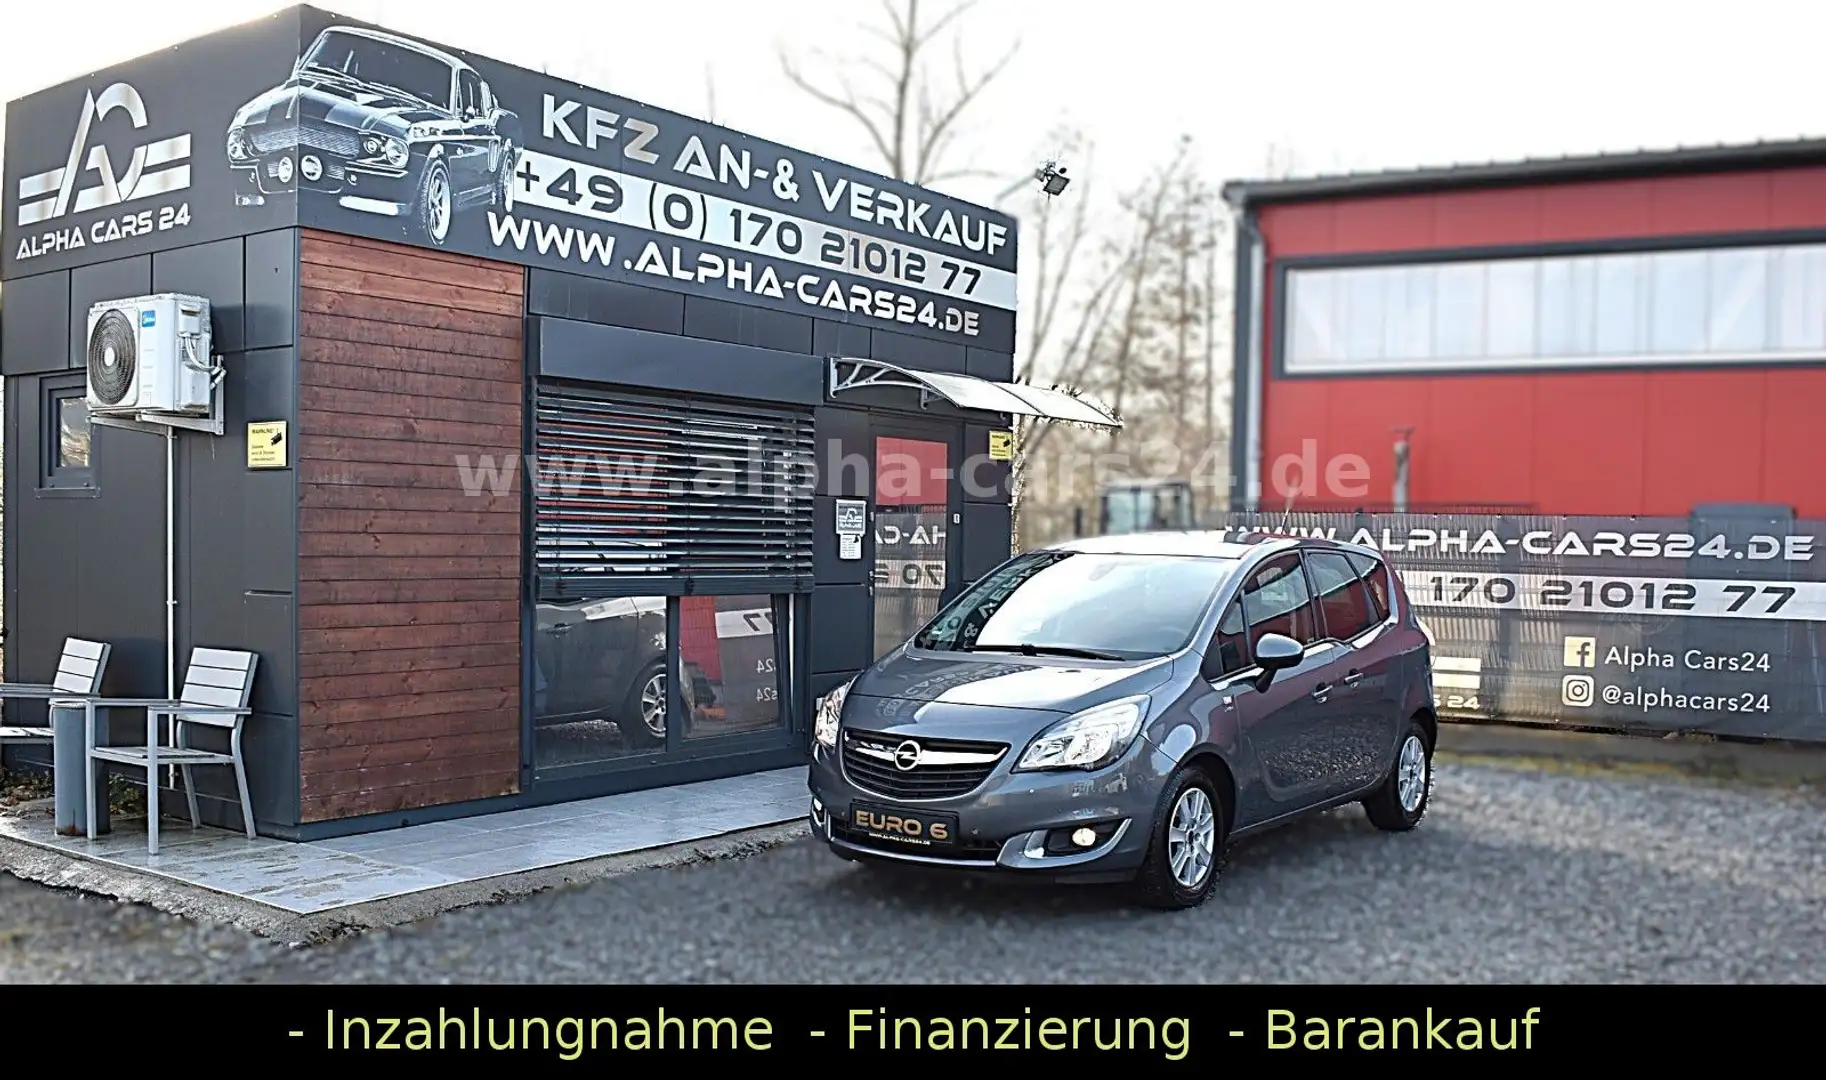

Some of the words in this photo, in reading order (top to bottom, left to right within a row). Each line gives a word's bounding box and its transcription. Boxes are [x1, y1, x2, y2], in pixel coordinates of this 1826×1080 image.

[543, 94, 660, 164] KFZ
[811, 170, 1008, 256] VERKAUF
[16, 226, 86, 260] ALPHA
[91, 210, 153, 244] CARS
[158, 202, 191, 231] 24
[516, 160, 624, 214] +49
[650, 182, 708, 242] (0)
[728, 208, 803, 256] 170
[820, 231, 927, 285] 21012
[940, 259, 982, 296] 77
[1430, 575, 1516, 605] 170
[1540, 579, 1697, 611] 21012
[1723, 585, 1797, 614] 77
[1604, 646, 1675, 673] Alpha
[1685, 649, 1771, 673] Cars24
[1447, 695, 1480, 710] 24
[1602, 684, 1771, 713] @alphacars24
[856, 810, 922, 836] EURO
[929, 822, 948, 840] 6
